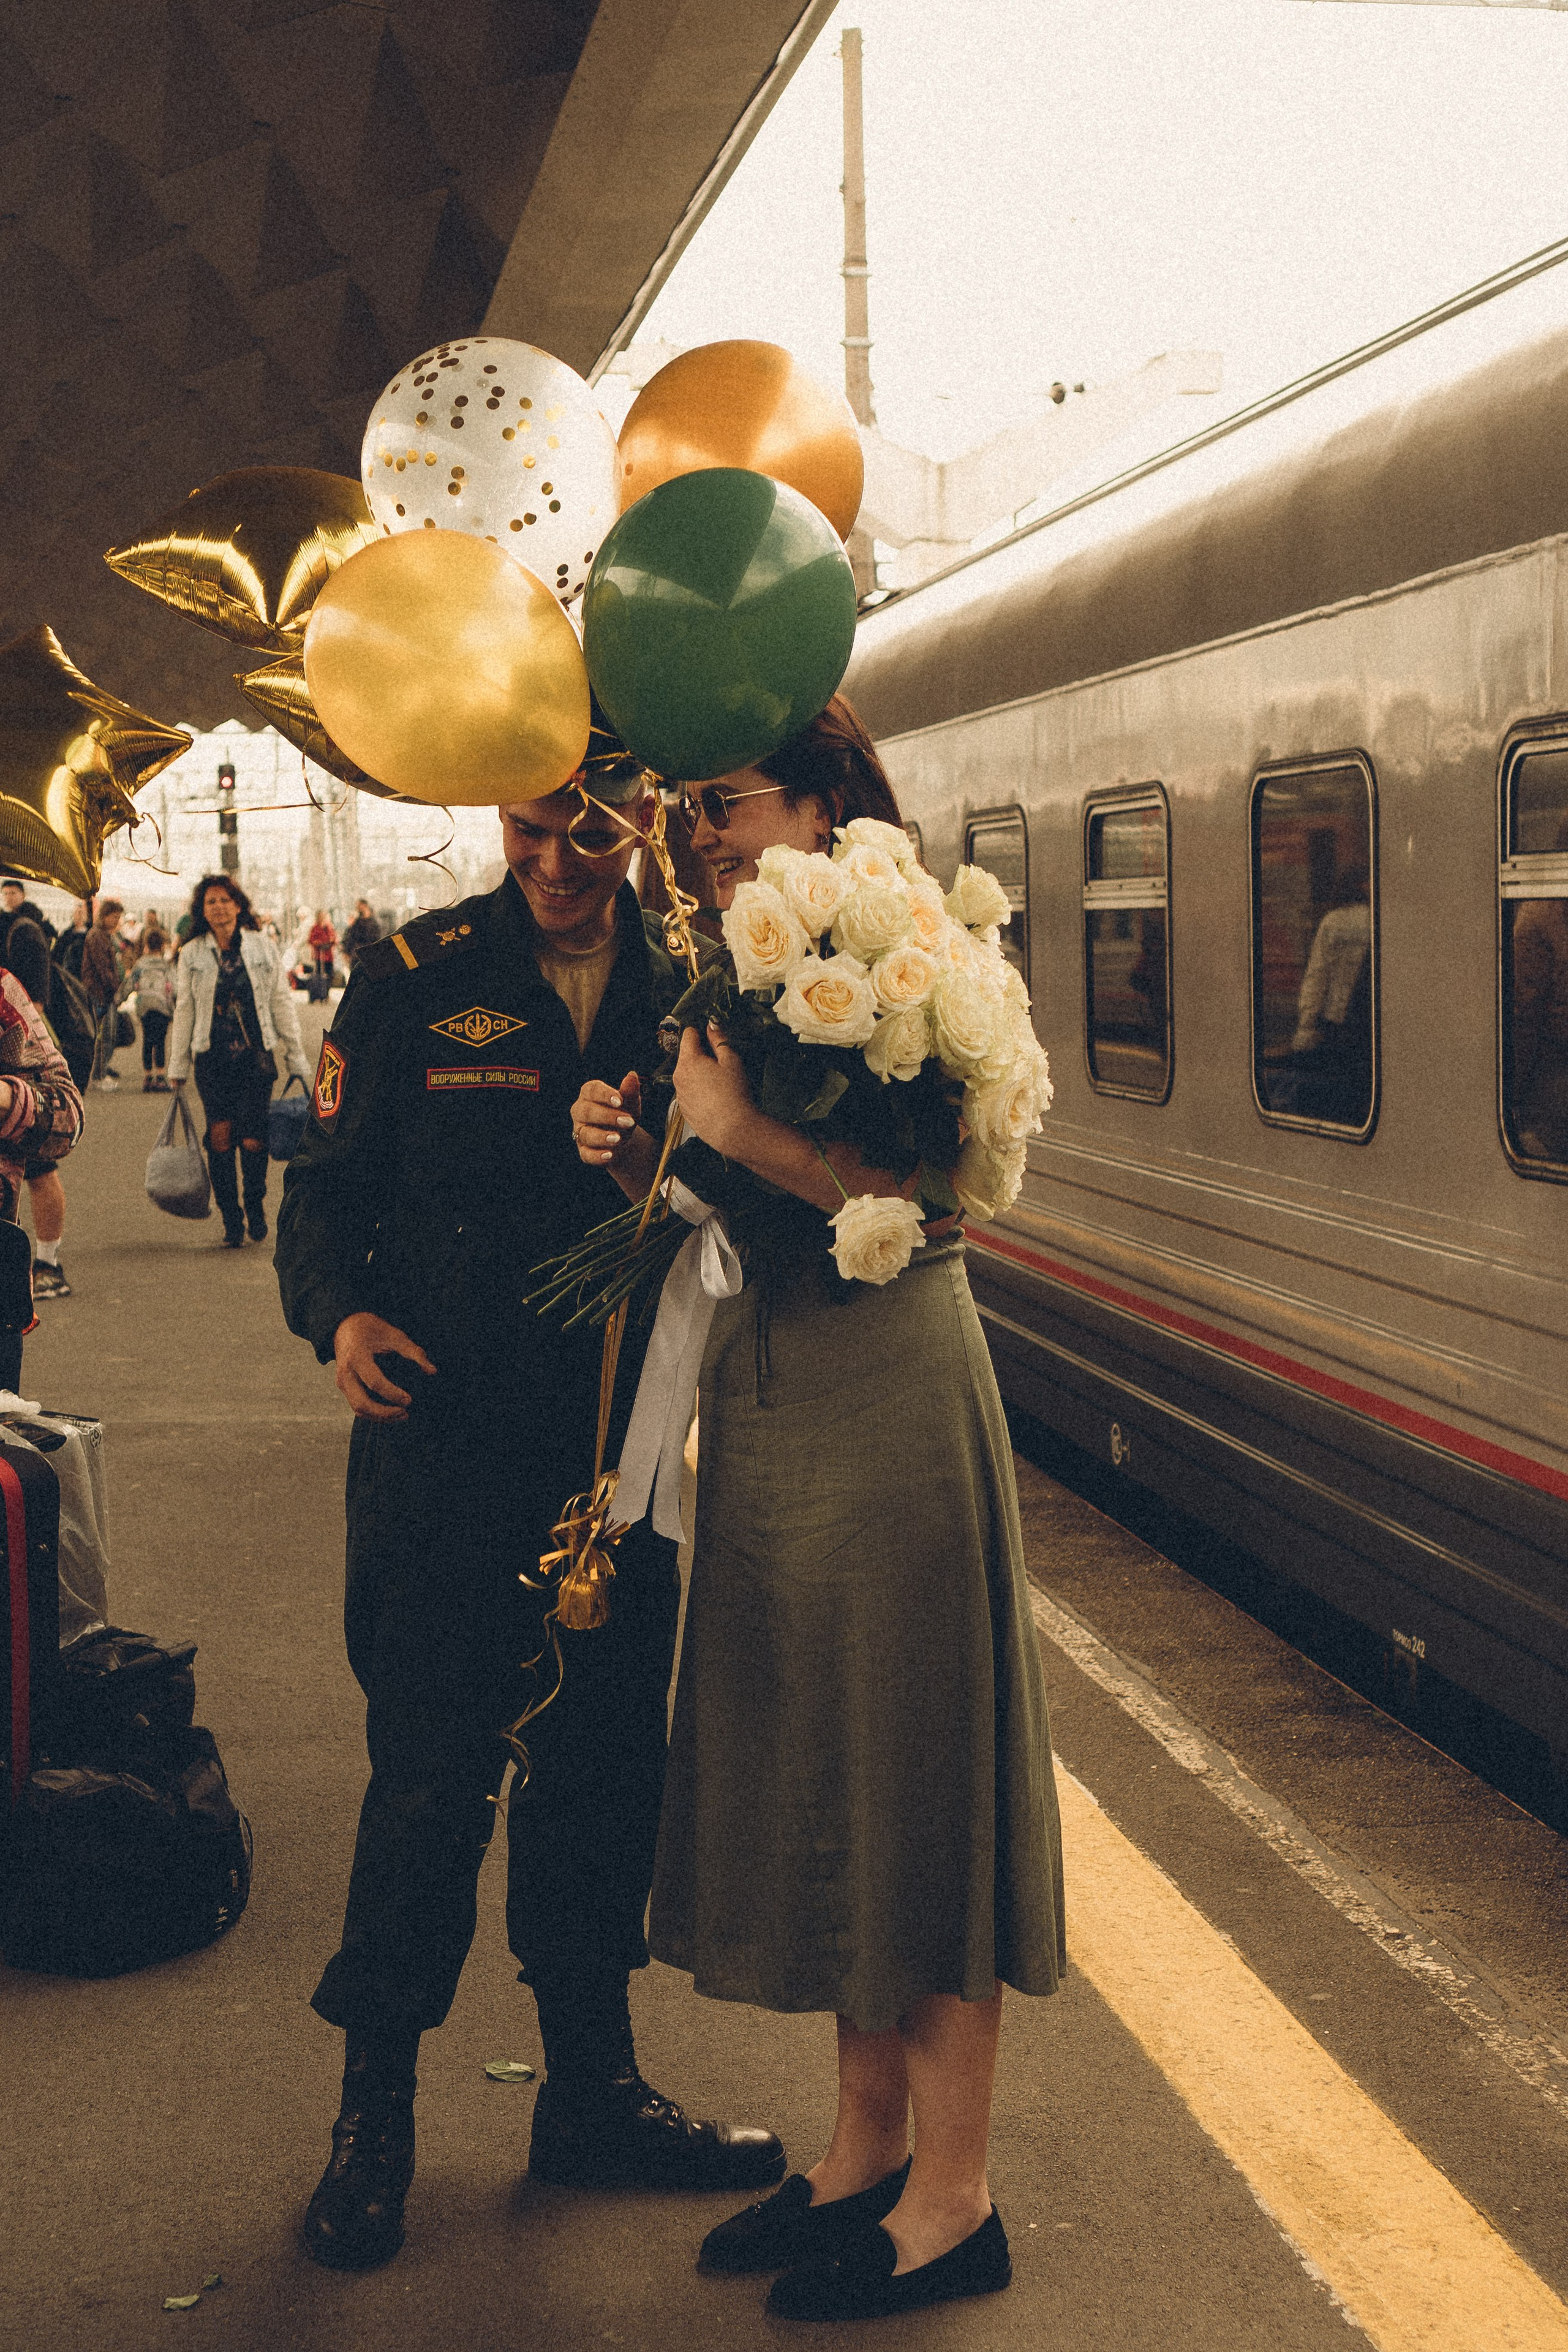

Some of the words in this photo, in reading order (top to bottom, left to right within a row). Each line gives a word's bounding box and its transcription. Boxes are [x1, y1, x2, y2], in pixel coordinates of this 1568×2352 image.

[448, 1023, 462, 1033] РВ
[493, 1019, 508, 1030] СН
[431, 1072, 483, 1085] ВООРУЖЕННЫЕ
[486, 1072, 505, 1082] СИЛЫ
[508, 1074, 536, 1086] РОССИИ
[1412, 1635, 1425, 1660] 242
